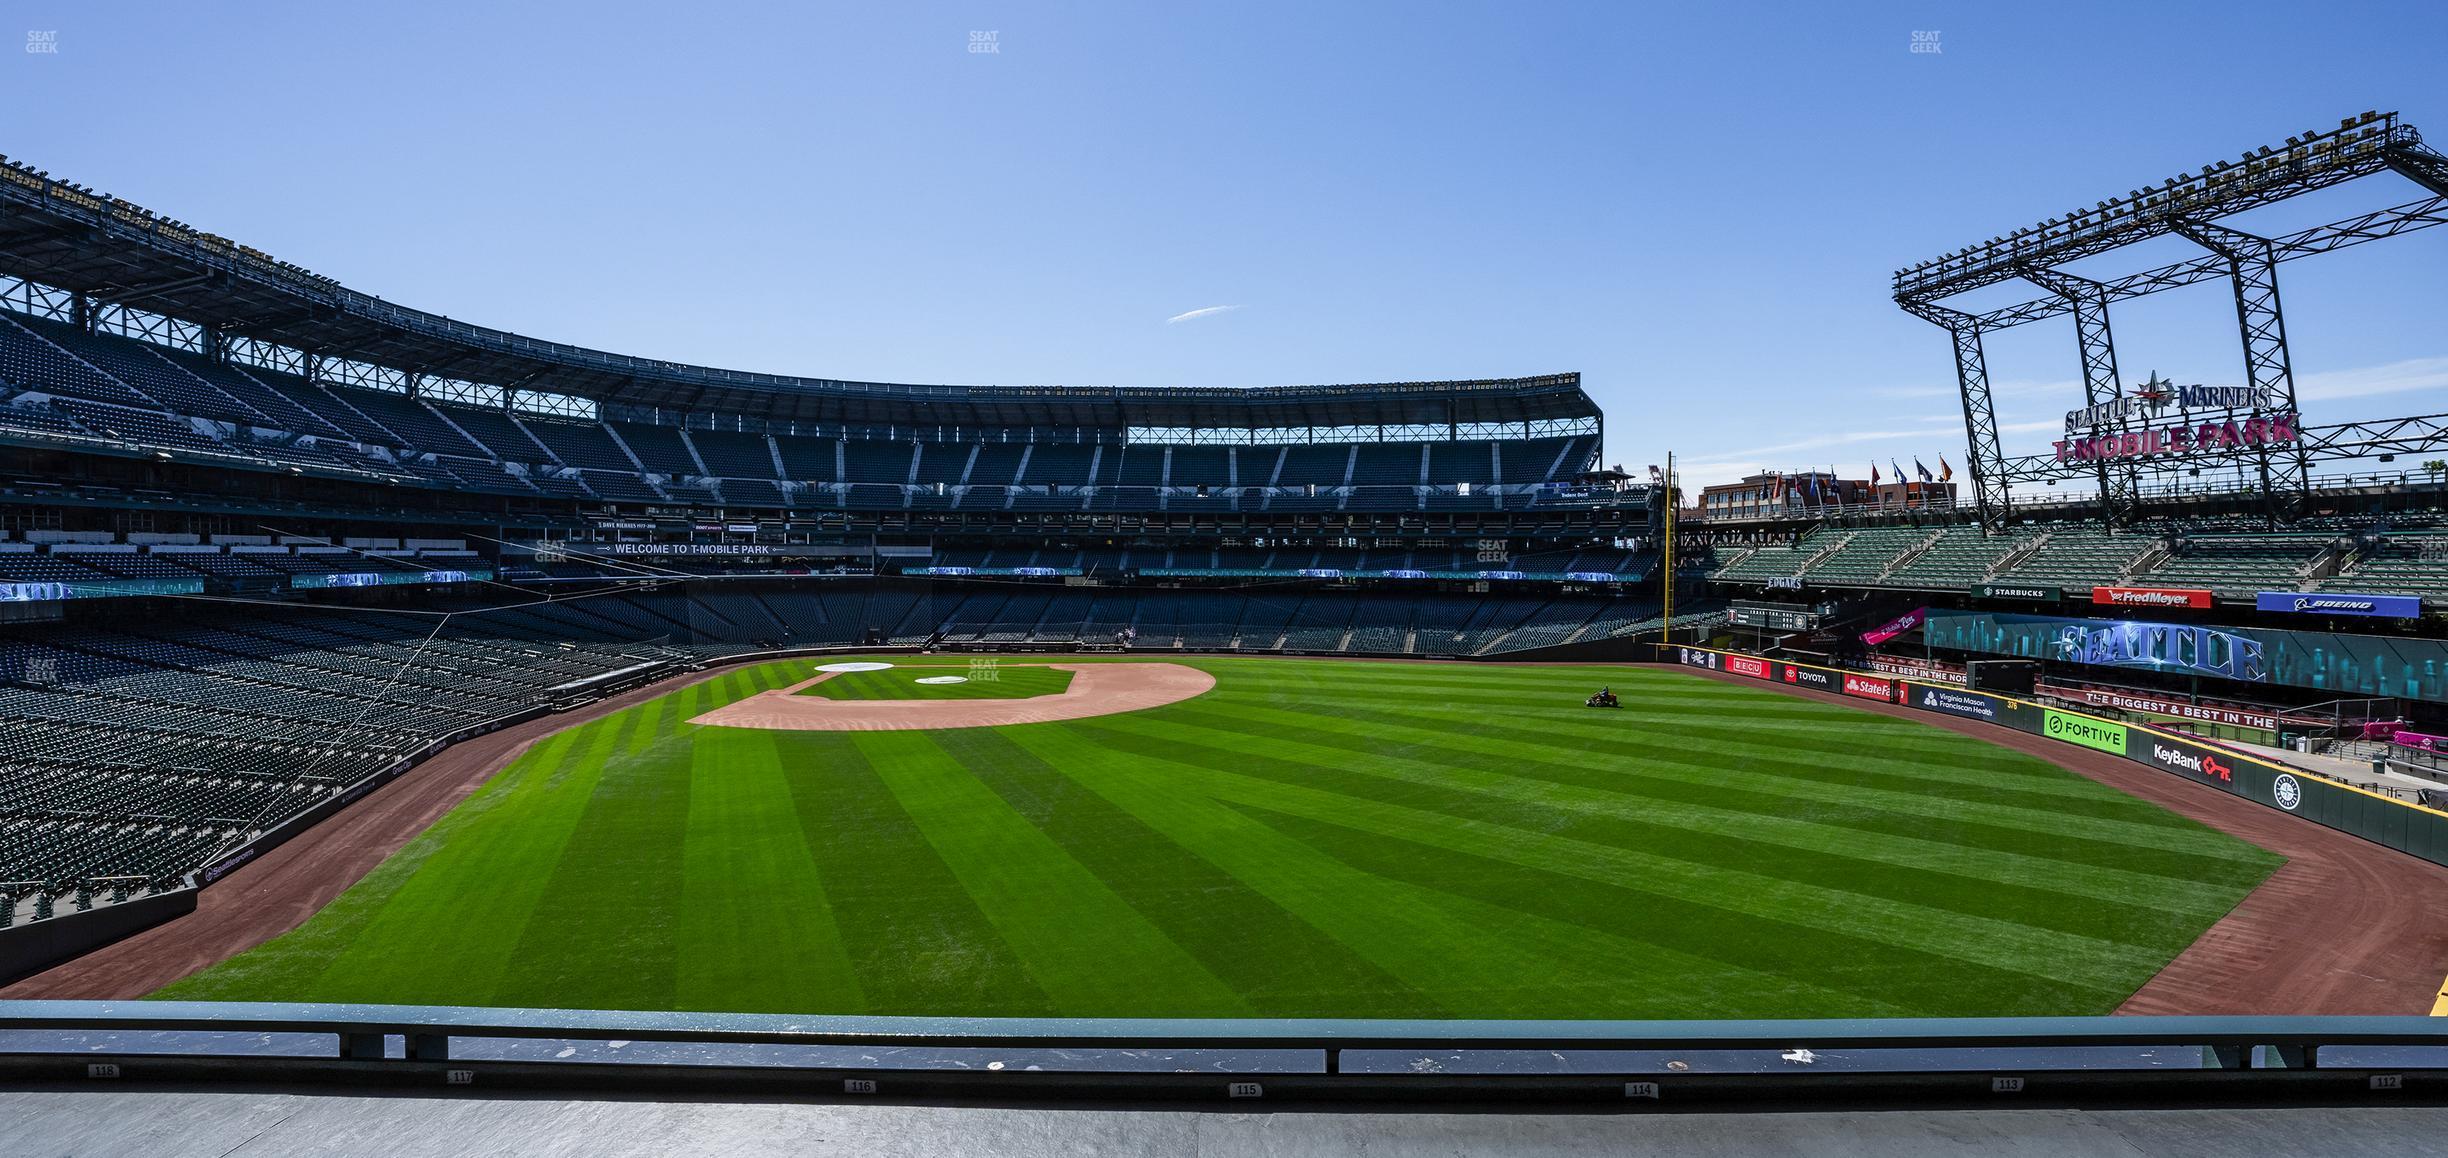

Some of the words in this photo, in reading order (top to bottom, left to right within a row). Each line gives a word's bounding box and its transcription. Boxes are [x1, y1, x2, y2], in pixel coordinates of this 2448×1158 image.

[2177, 384, 2272, 410] MARINERS
[2052, 426, 2191, 463] T-MOBILE
[2199, 411, 2302, 450] PARK
[615, 544, 669, 554] WELCOME
[673, 544, 687, 554] TO
[741, 545, 769, 554] PARK
[1995, 588, 2044, 597] STARBUCKS
[2312, 600, 2372, 609] BOEING
[1735, 661, 1760, 672] BECU
[1798, 671, 1827, 684] TOYOTA
[1898, 666, 1918, 676] BEST
[1930, 671, 1947, 680] THE
[1940, 692, 1963, 702] Virginia
[1964, 697, 1985, 706] Mason
[1940, 700, 1972, 712] Franciscan
[1973, 706, 1994, 716] Health
[2007, 700, 2018, 710] 376
[2086, 693, 2109, 704] THE
[2112, 697, 2167, 712] BIGGEST
[2170, 705, 2179, 714] &
[2184, 707, 2220, 721] BEST
[2224, 712, 2239, 723] IN
[2244, 715, 2274, 728] THE
[2065, 722, 2121, 746] FORTIVE
[2154, 744, 2202, 772] KeyBank
[95, 1066, 114, 1076] 118
[454, 1071, 472, 1082] 117
[852, 1081, 871, 1091] 116
[1999, 1080, 2017, 1090] 113
[2377, 1077, 2396, 1087] 112
[1237, 1085, 1256, 1095] 115
[1633, 1084, 1651, 1095] 114
